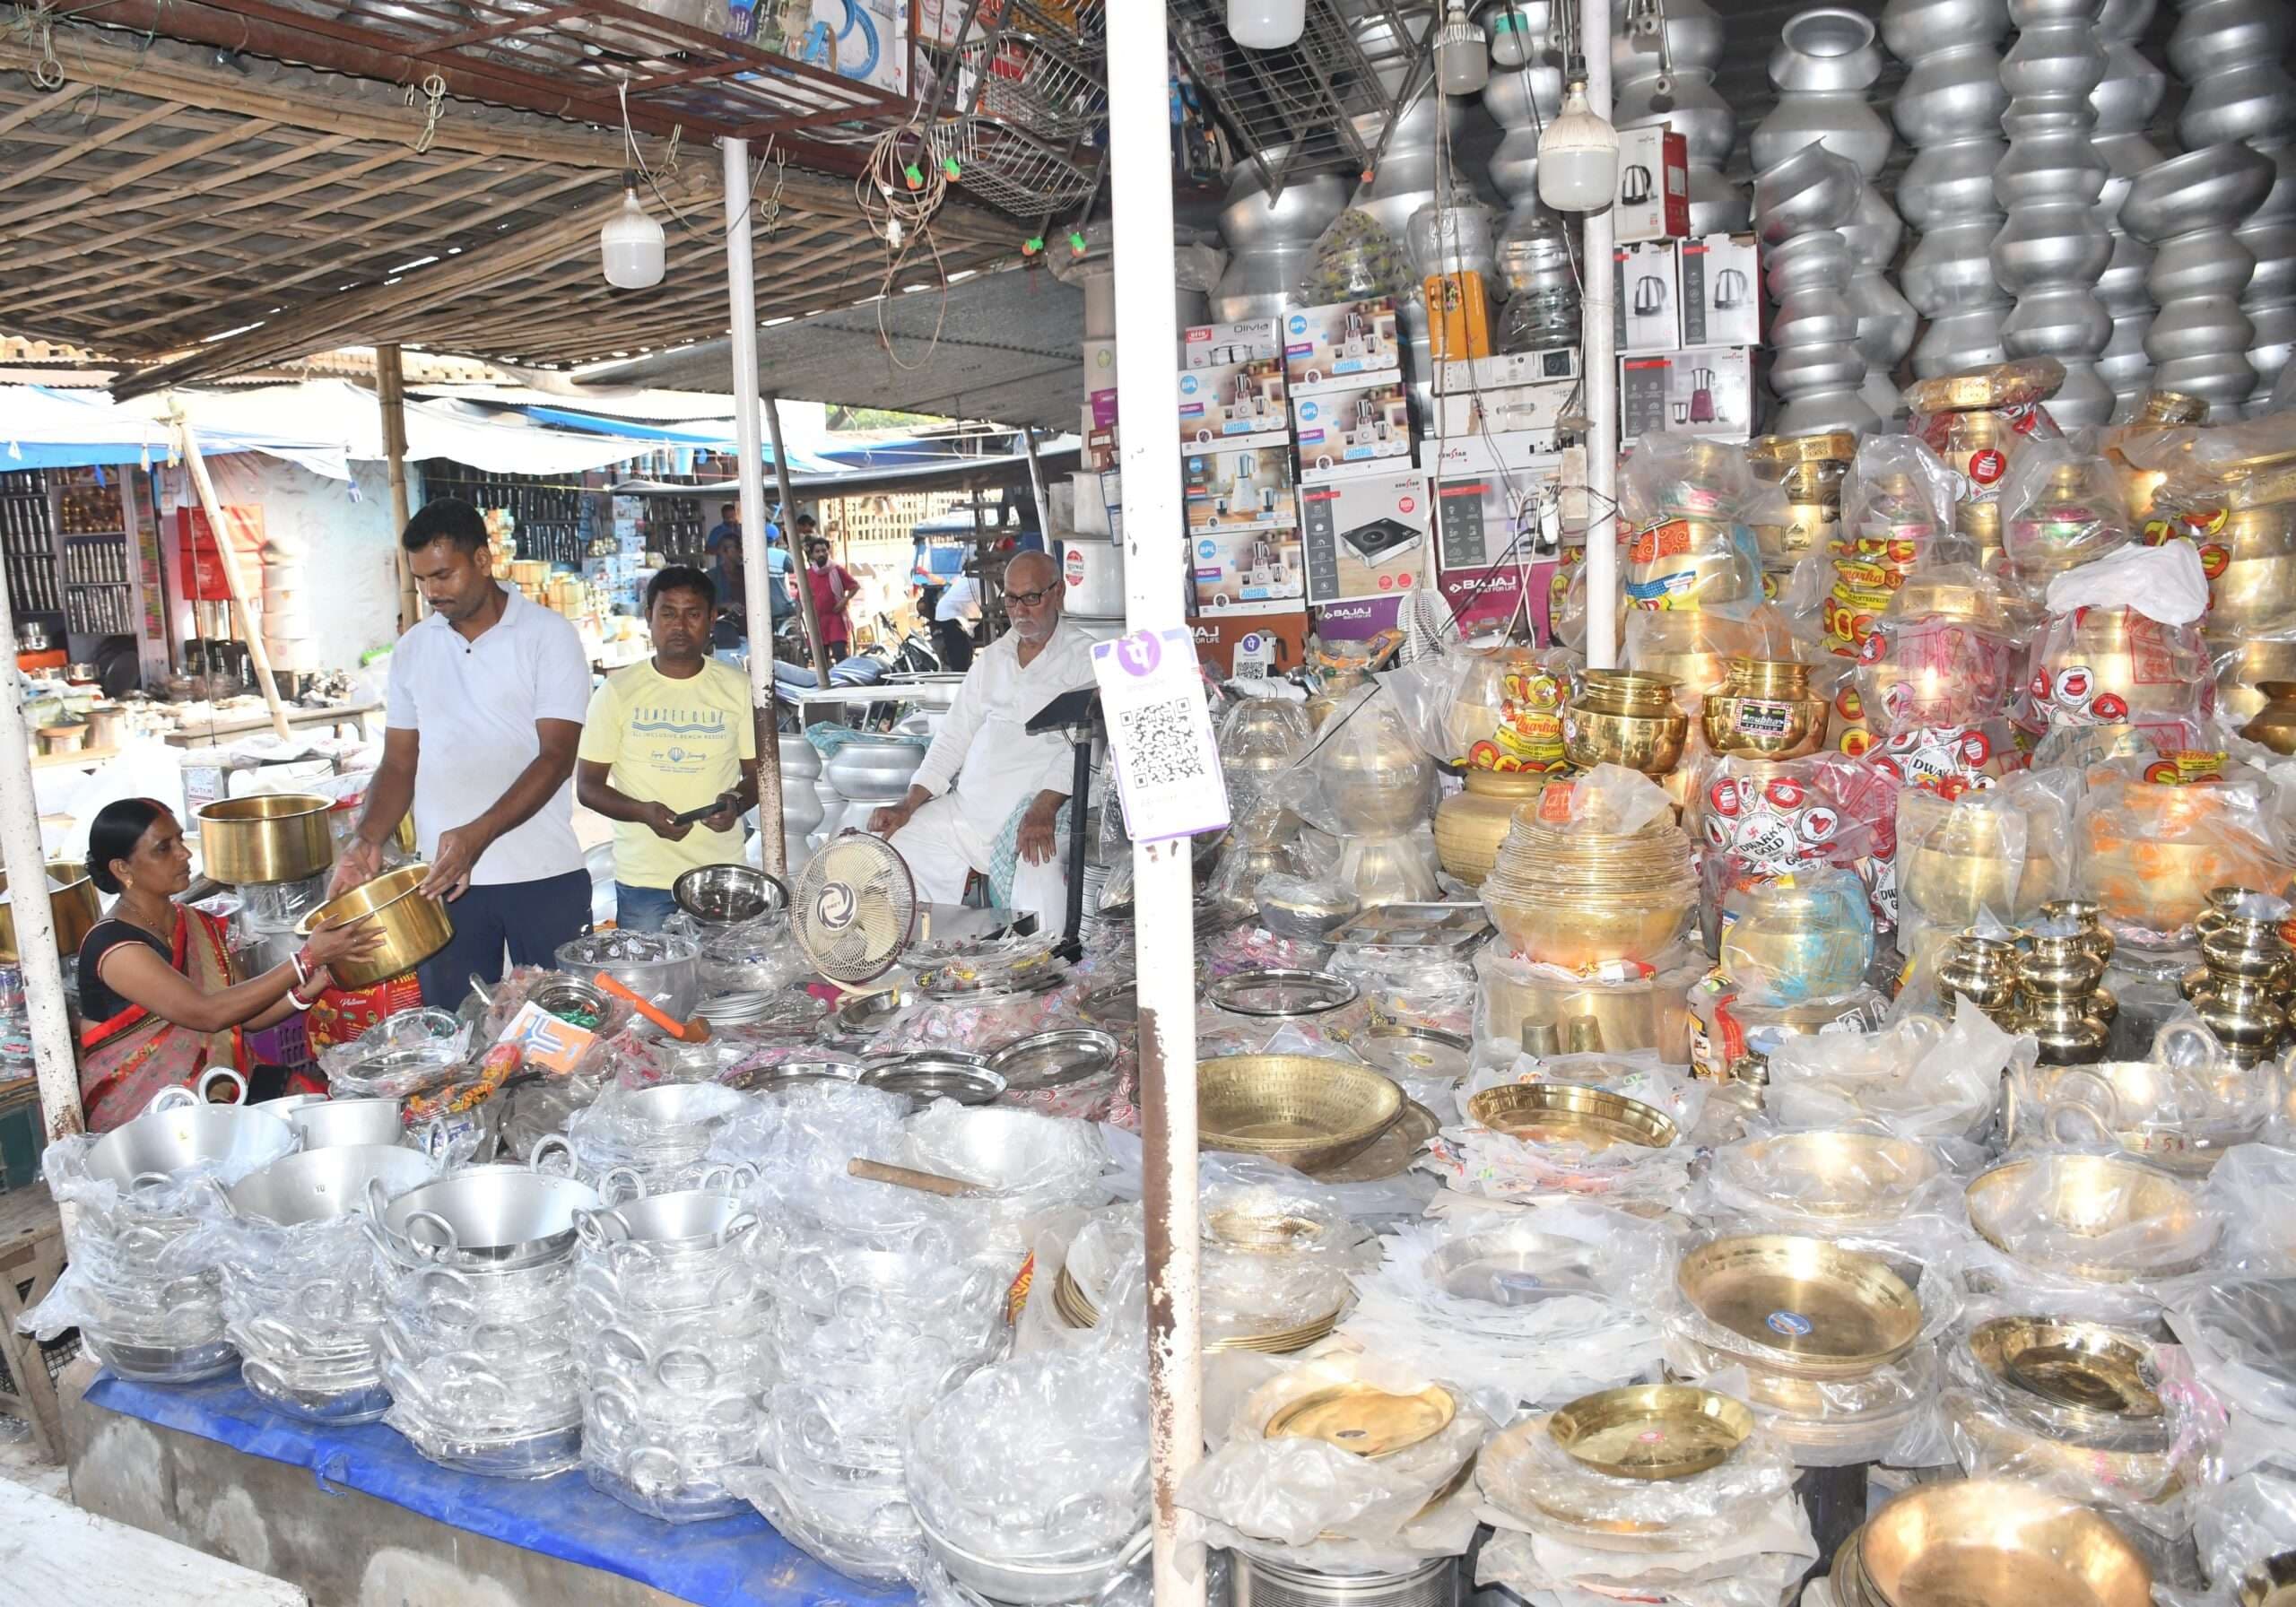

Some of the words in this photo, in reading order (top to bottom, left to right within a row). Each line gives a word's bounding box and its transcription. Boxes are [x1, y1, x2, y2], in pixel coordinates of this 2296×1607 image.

[1233, 323, 1269, 334] Olivia
[1198, 544, 1215, 554] BPL
[1463, 576, 1516, 589] BAJAJ
[1334, 606, 1371, 617] BAJAJ
[634, 707, 685, 722] SUNSET
[1739, 822, 1787, 852] DWARKA
[1754, 838, 1785, 856] GOLD
